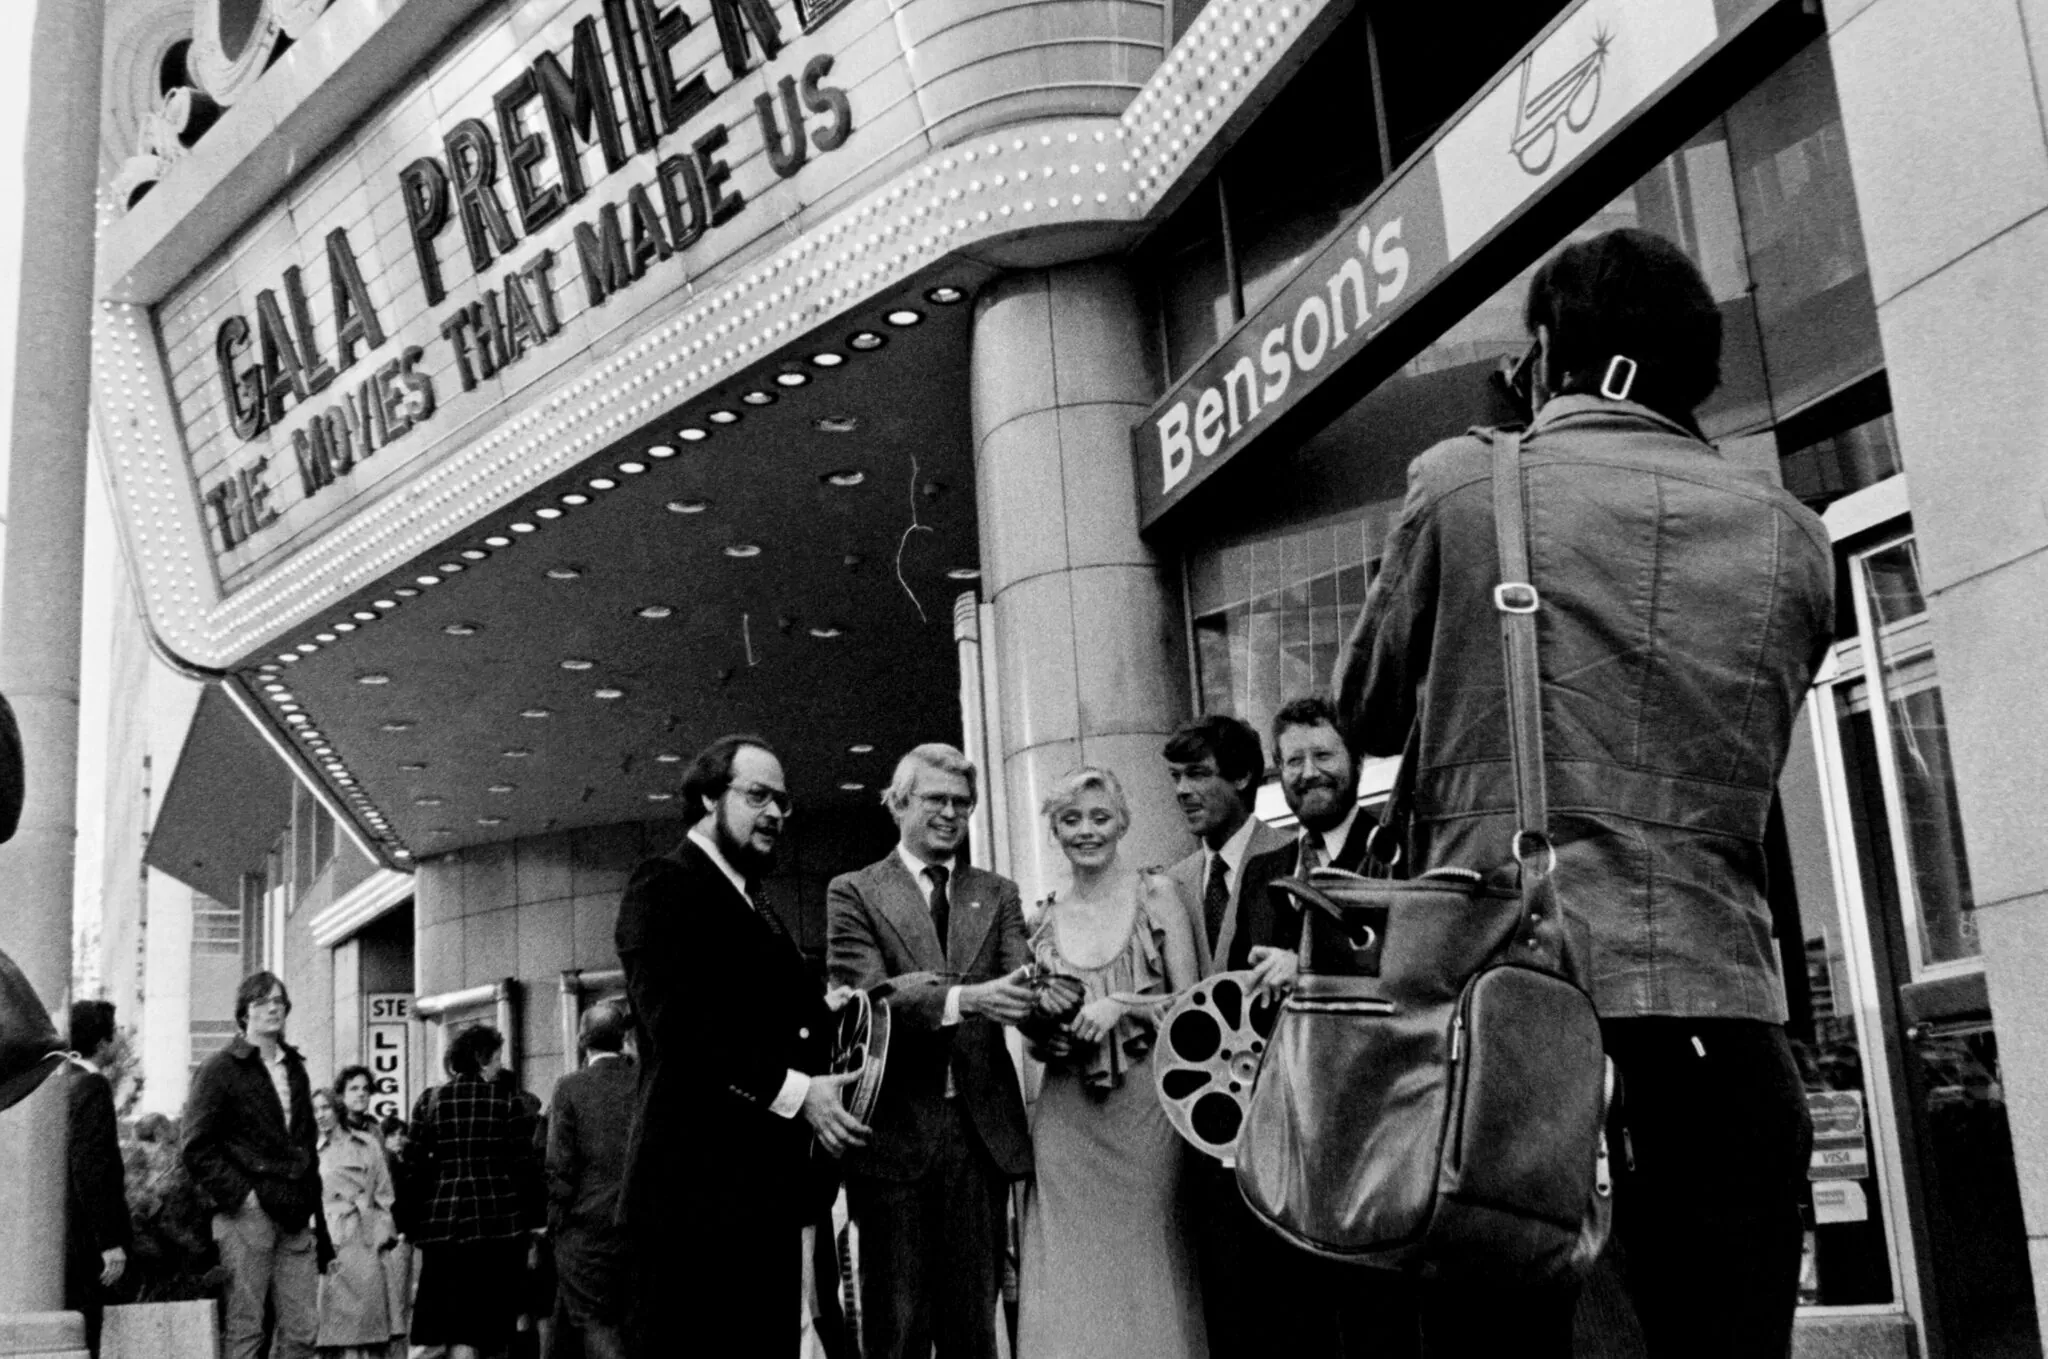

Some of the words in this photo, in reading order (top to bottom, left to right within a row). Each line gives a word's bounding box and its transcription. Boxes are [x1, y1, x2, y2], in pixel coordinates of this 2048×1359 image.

[206, 455, 280, 552] THE
[292, 345, 436, 500] MOVIES
[440, 248, 562, 392] THAT
[573, 123, 746, 307] MADE
[754, 53, 852, 178] US
[216, 226, 386, 441] GALA
[399, 0, 856, 306] PREMIE
[1157, 217, 1410, 495] Benson's
[1822, 1151, 1850, 1164] VISA
